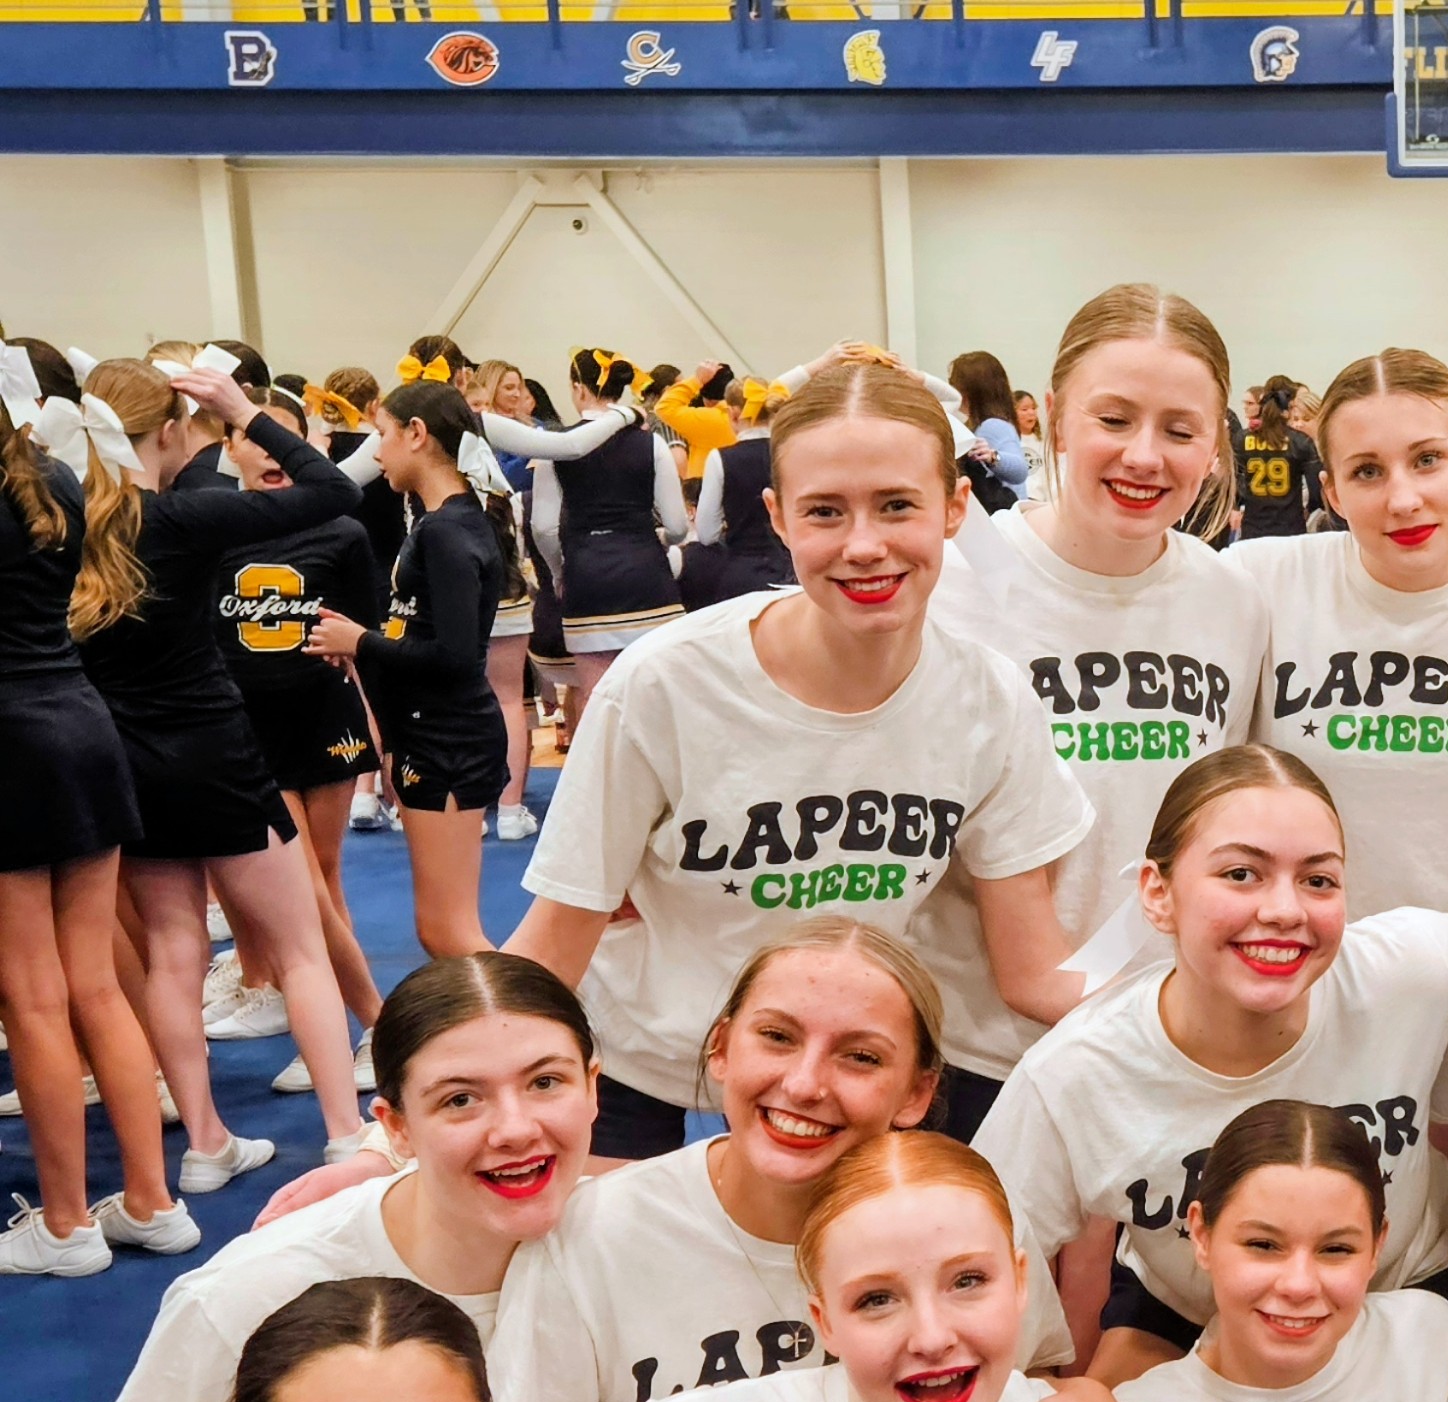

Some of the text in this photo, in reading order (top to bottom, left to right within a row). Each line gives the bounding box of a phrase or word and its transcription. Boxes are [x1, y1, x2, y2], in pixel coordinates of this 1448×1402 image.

[1246, 457, 1291, 497] 29
[219, 594, 323, 621] Oxford
[679, 790, 965, 872] LAPEER
[751, 864, 907, 909] CHEER
